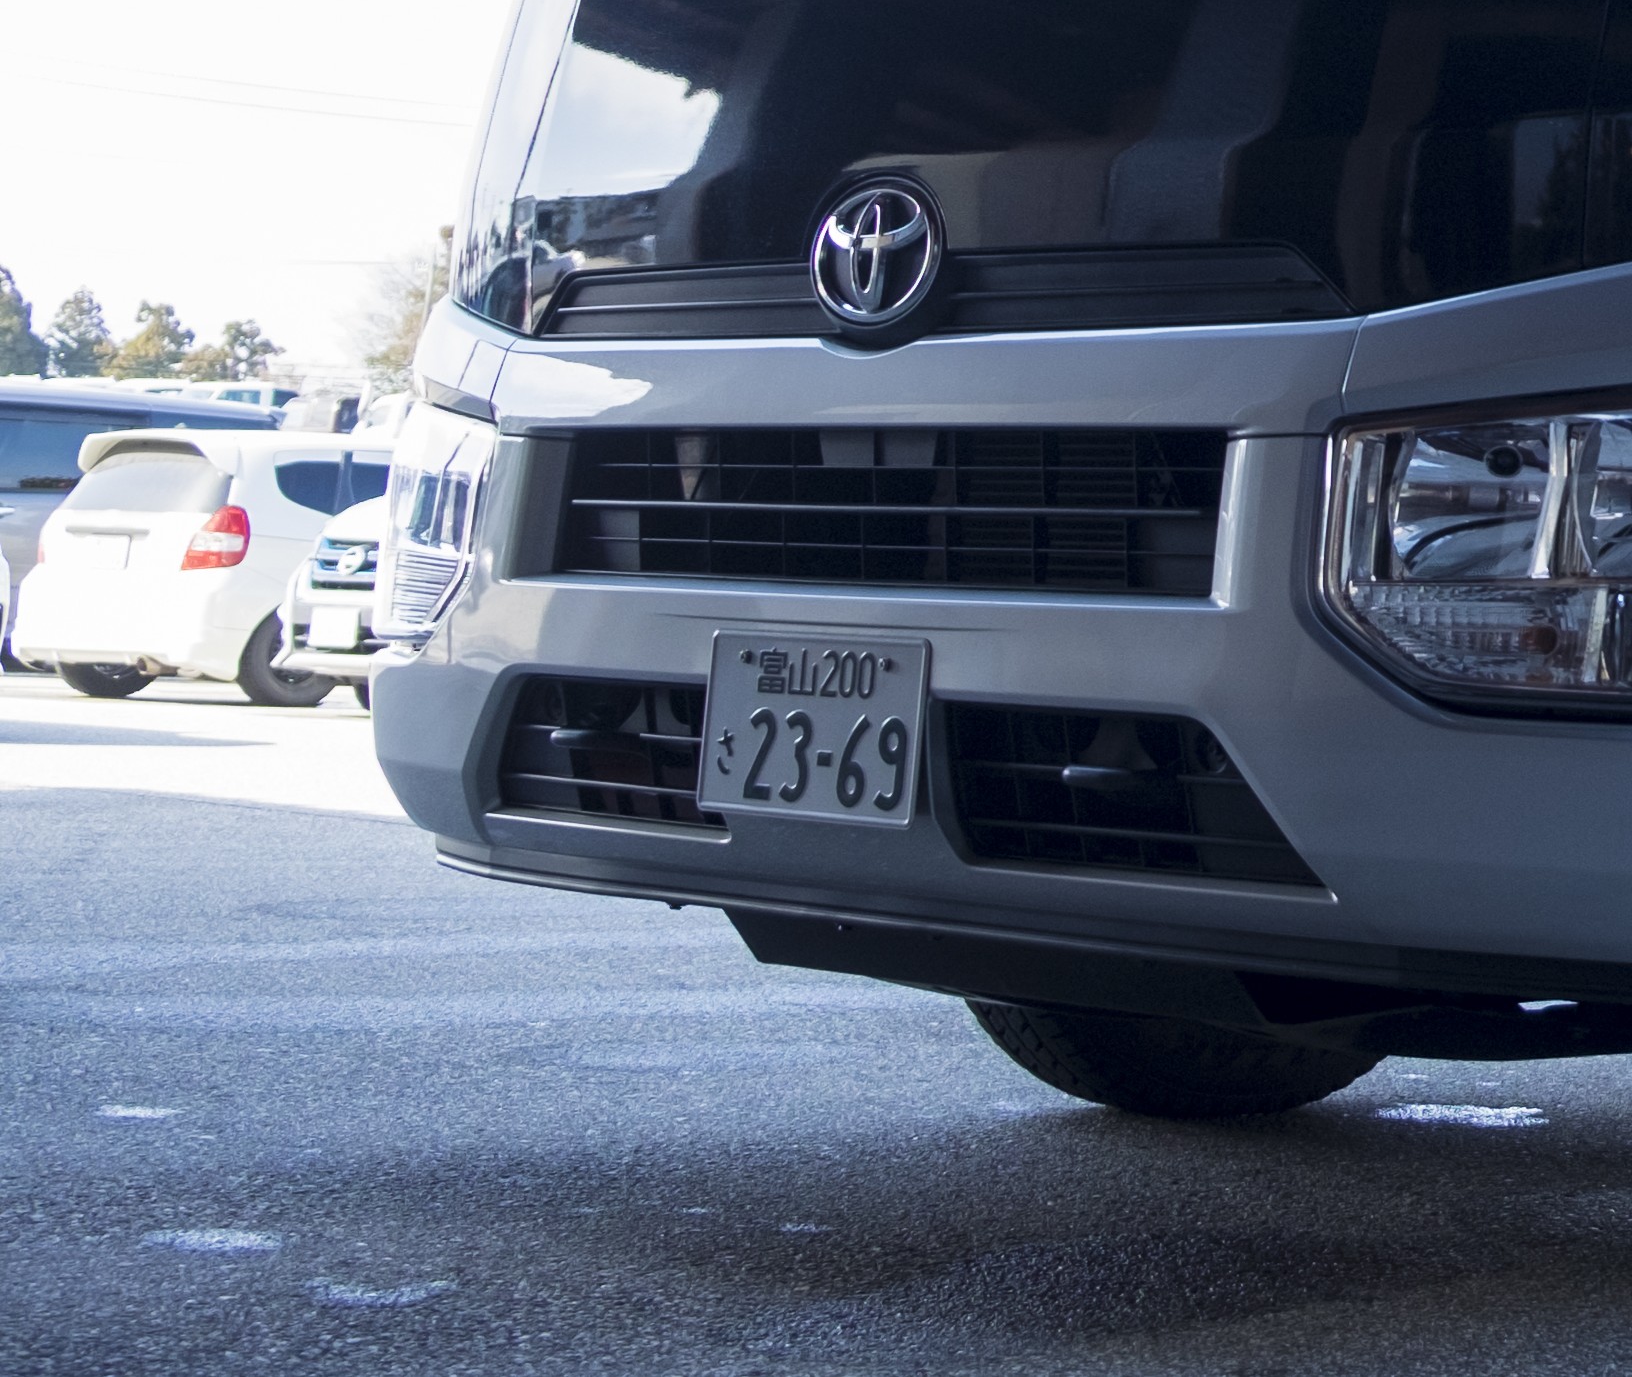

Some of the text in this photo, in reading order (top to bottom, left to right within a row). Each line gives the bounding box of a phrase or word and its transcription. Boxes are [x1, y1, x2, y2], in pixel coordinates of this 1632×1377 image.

[757, 647, 876, 699] 富山200
[717, 707, 907, 811] さ 23-69
